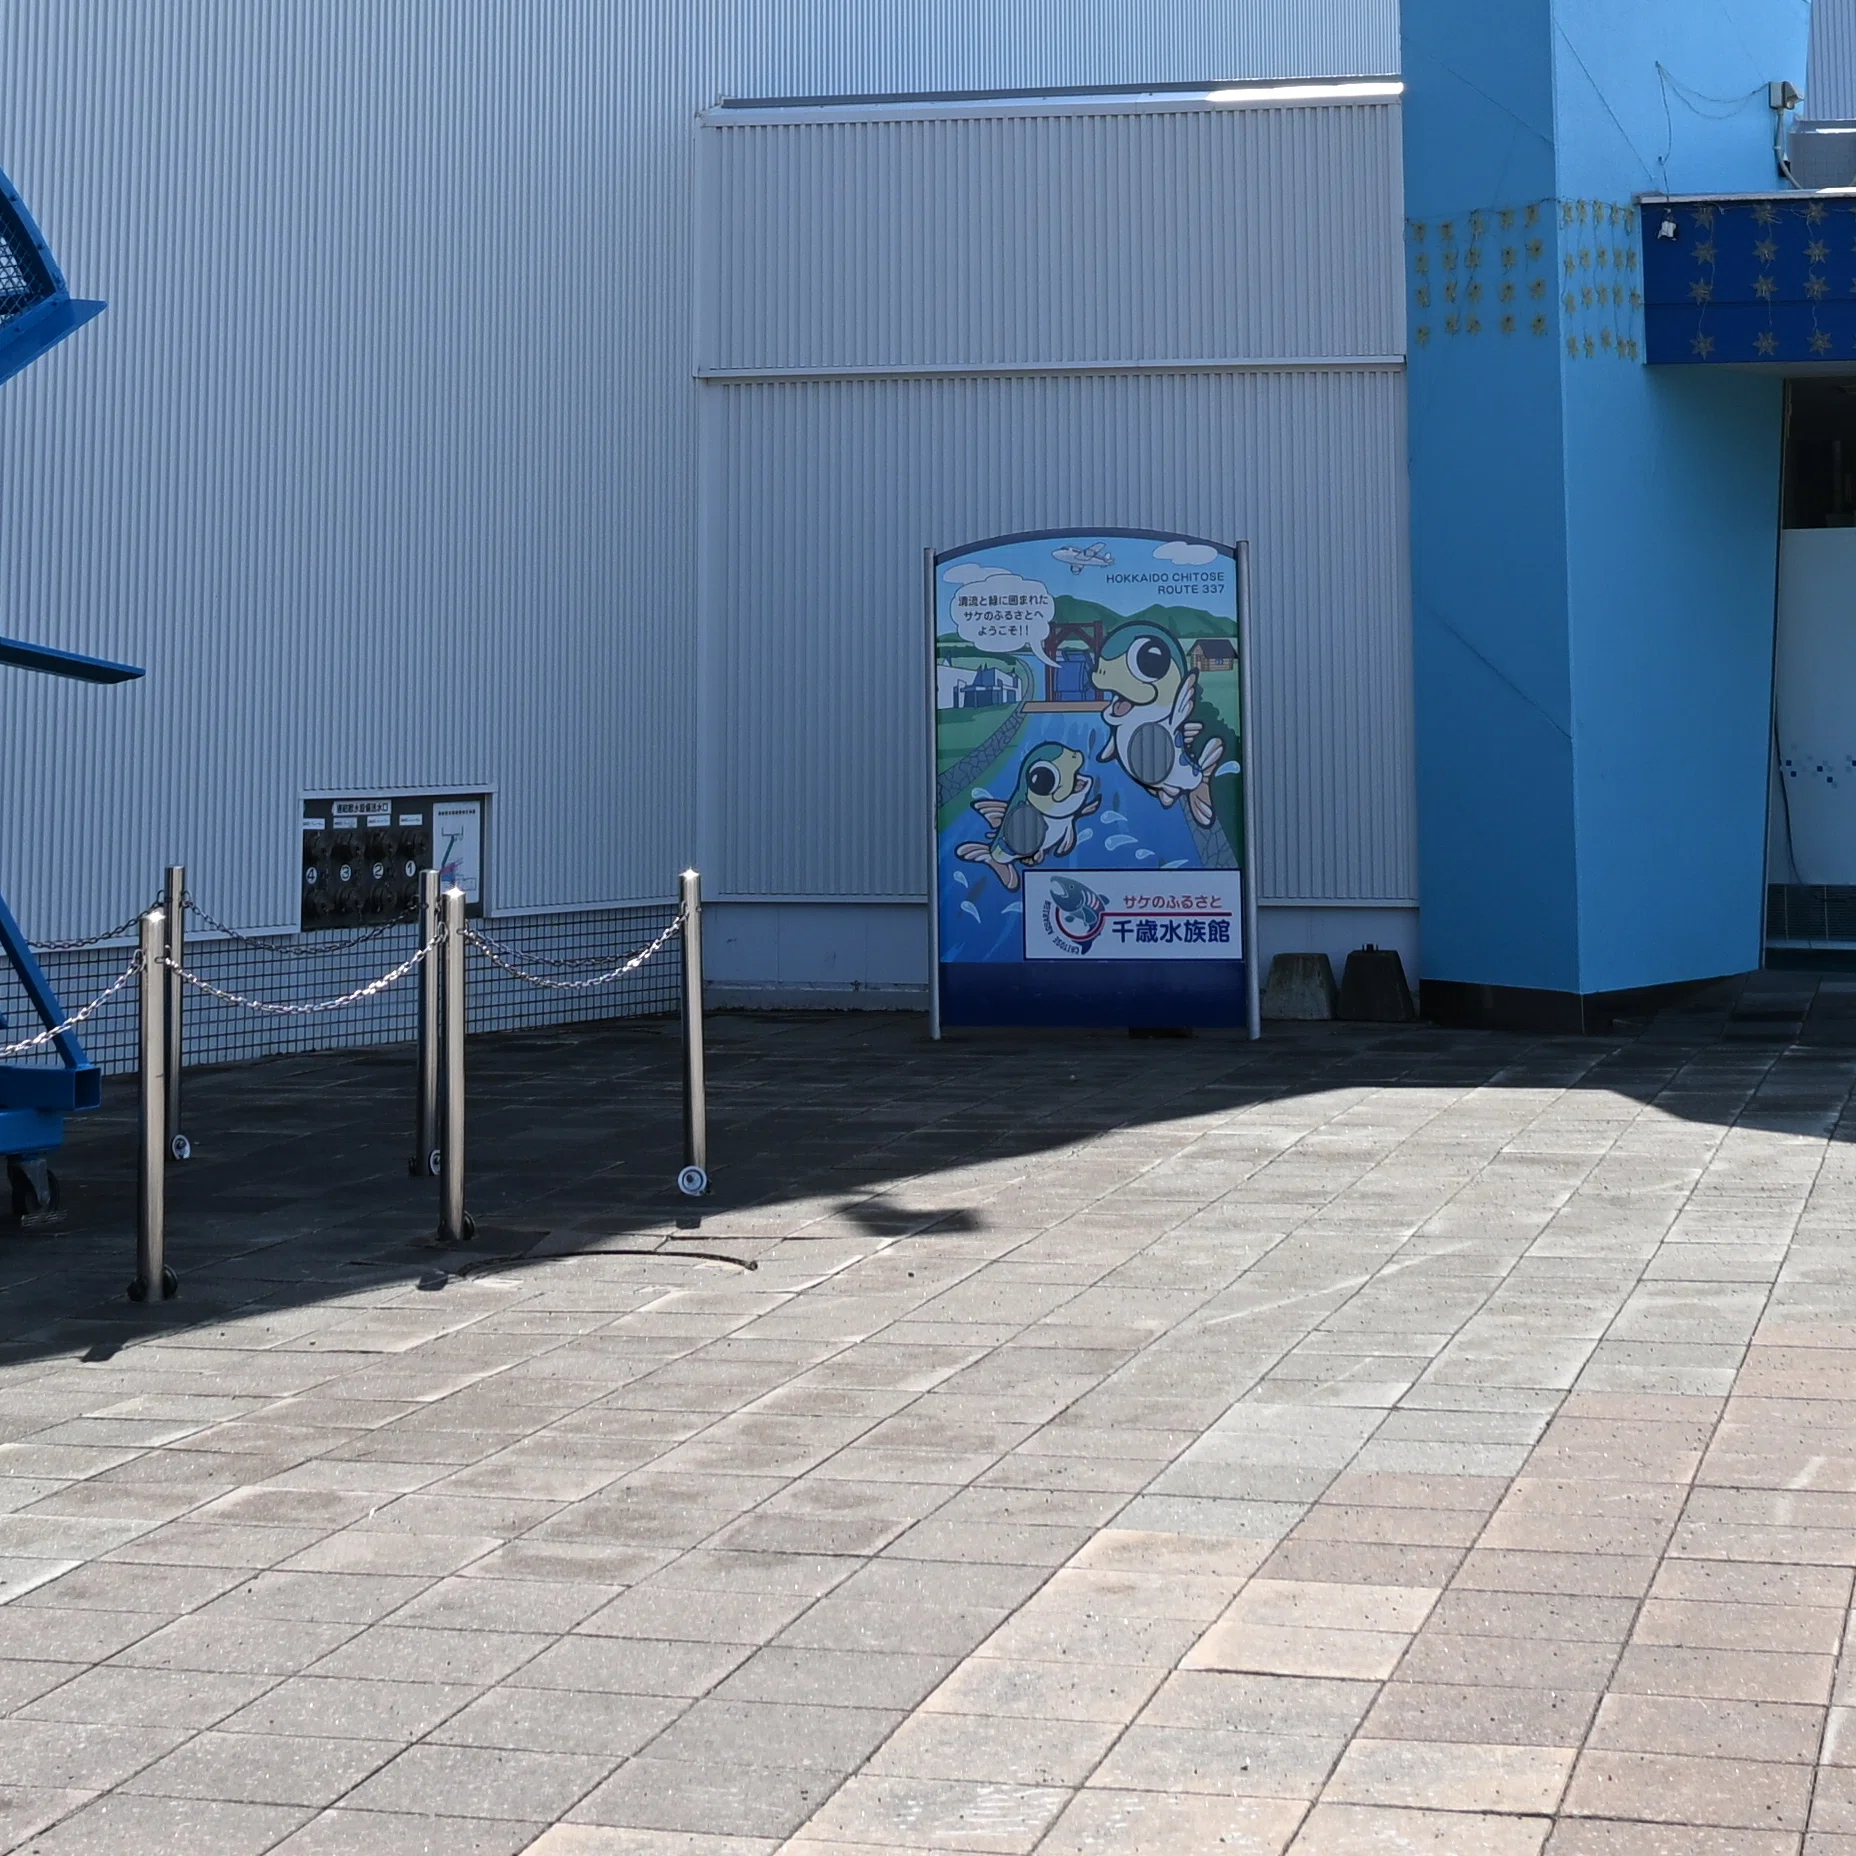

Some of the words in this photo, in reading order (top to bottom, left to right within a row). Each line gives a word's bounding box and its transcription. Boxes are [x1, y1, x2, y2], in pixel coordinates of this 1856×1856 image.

[1106, 573, 1169, 584] HOKKAIDO
[1172, 571, 1225, 582] CHITOSE
[1158, 584, 1199, 595] ROUTE
[1202, 584, 1225, 594] 337
[958, 595, 1049, 607] 清流と緑に囲まれた
[964, 610, 1044, 621] サケのふるさとへ
[1123, 895, 1222, 909] サケのふるさと
[1112, 919, 1230, 943] 千歳水族館
